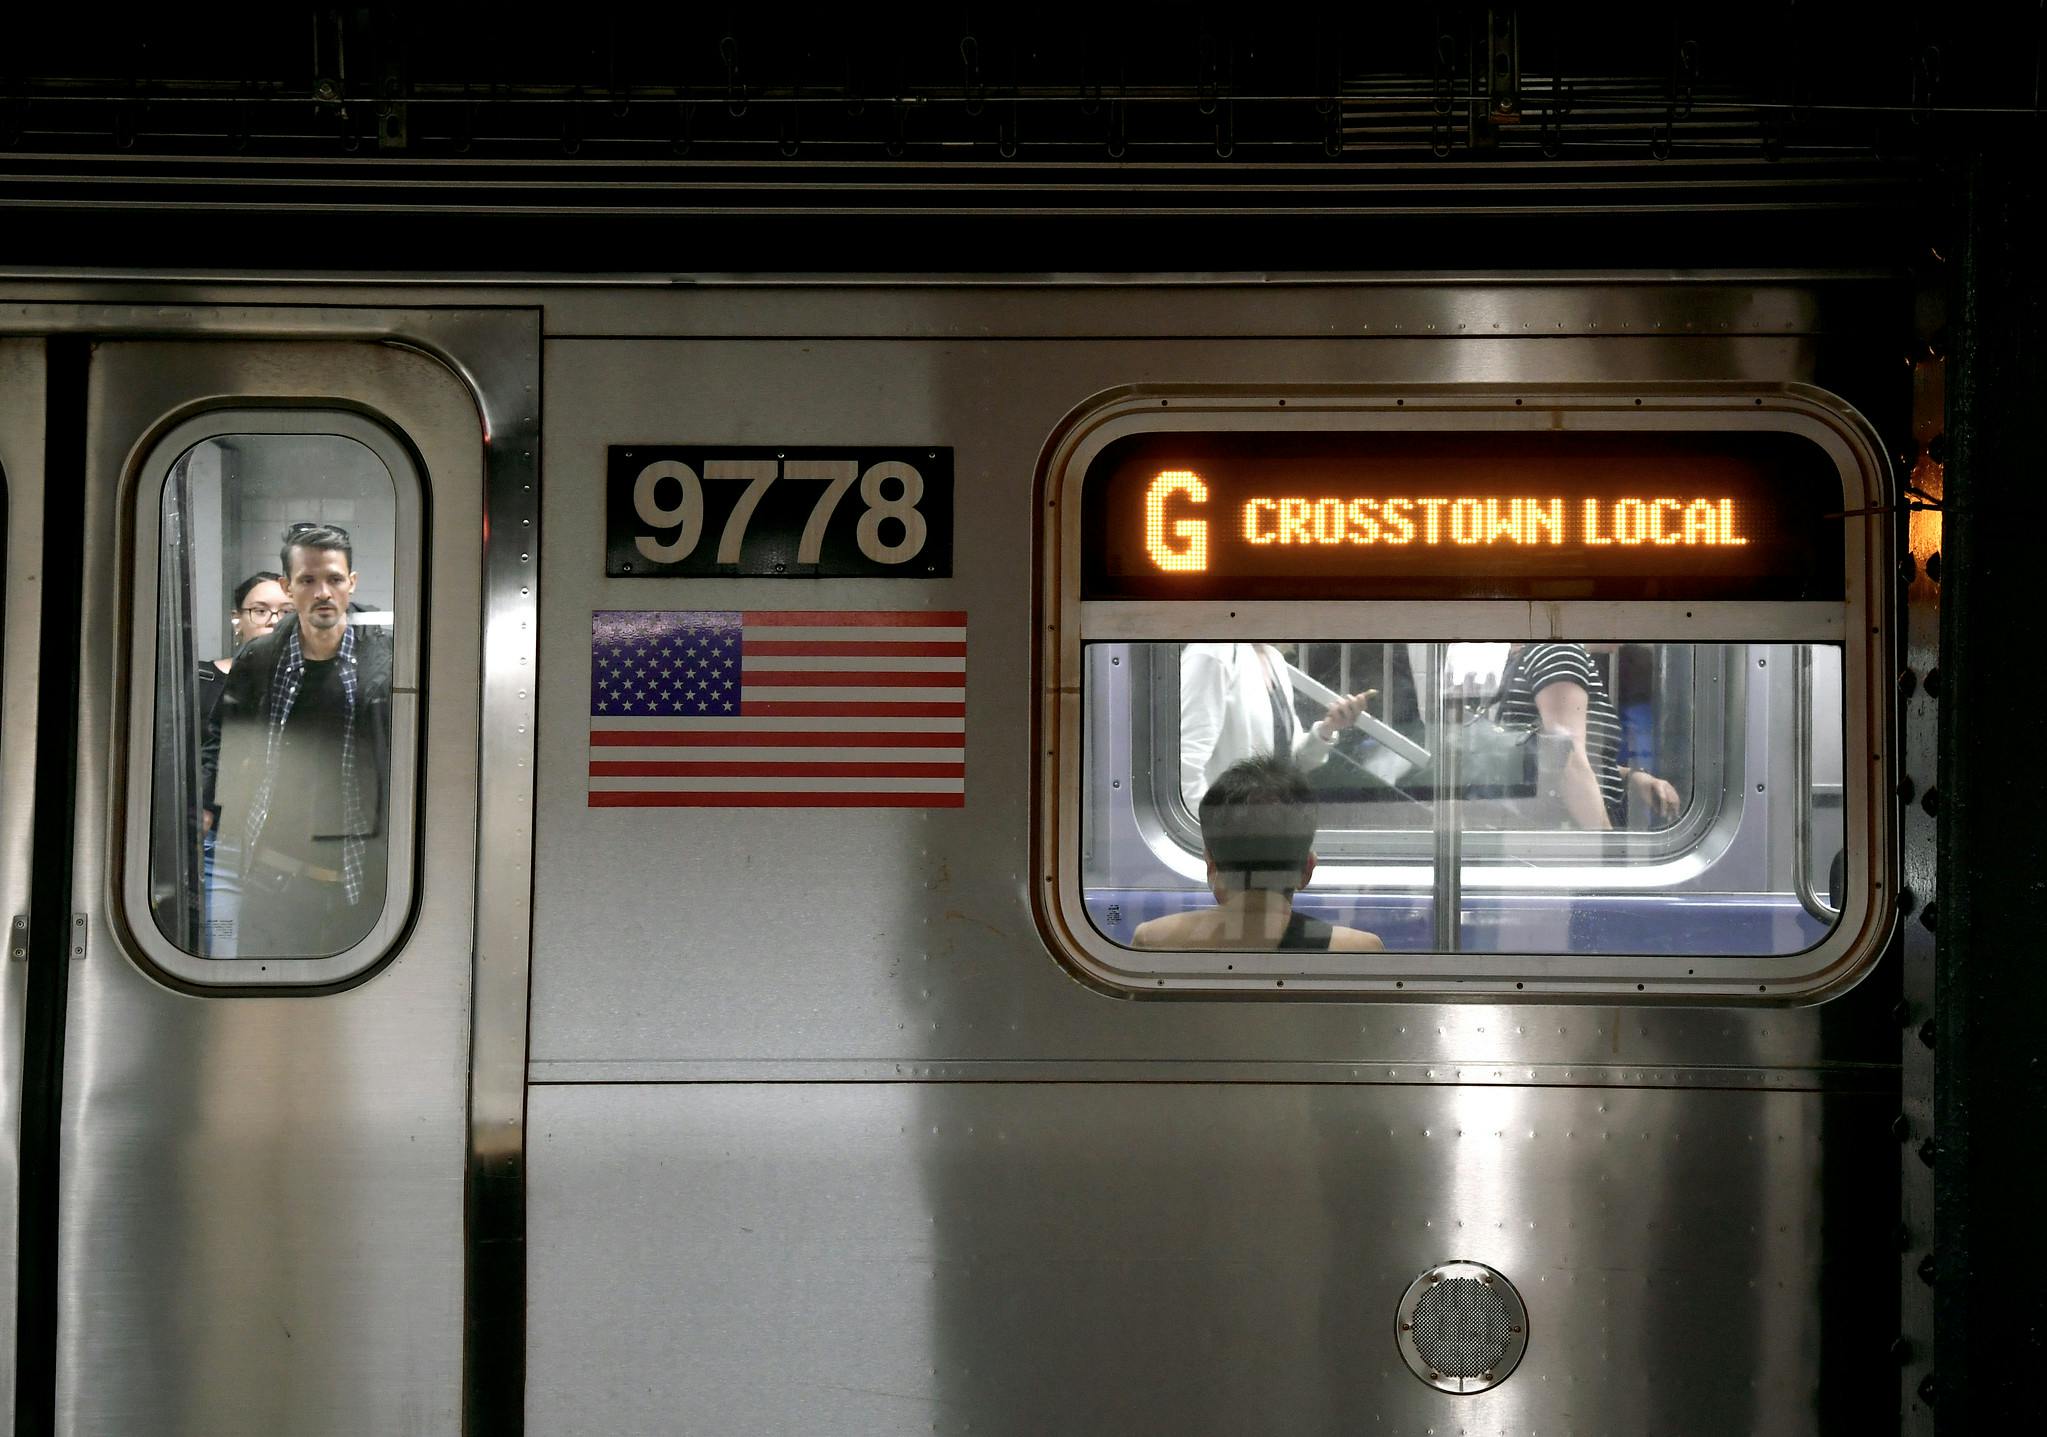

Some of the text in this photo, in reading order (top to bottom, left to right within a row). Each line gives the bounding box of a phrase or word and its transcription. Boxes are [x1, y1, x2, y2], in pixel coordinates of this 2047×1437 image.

[633, 459, 928, 565] 9778
[1144, 470, 1748, 573] G CROSSTOWN LOCAL
